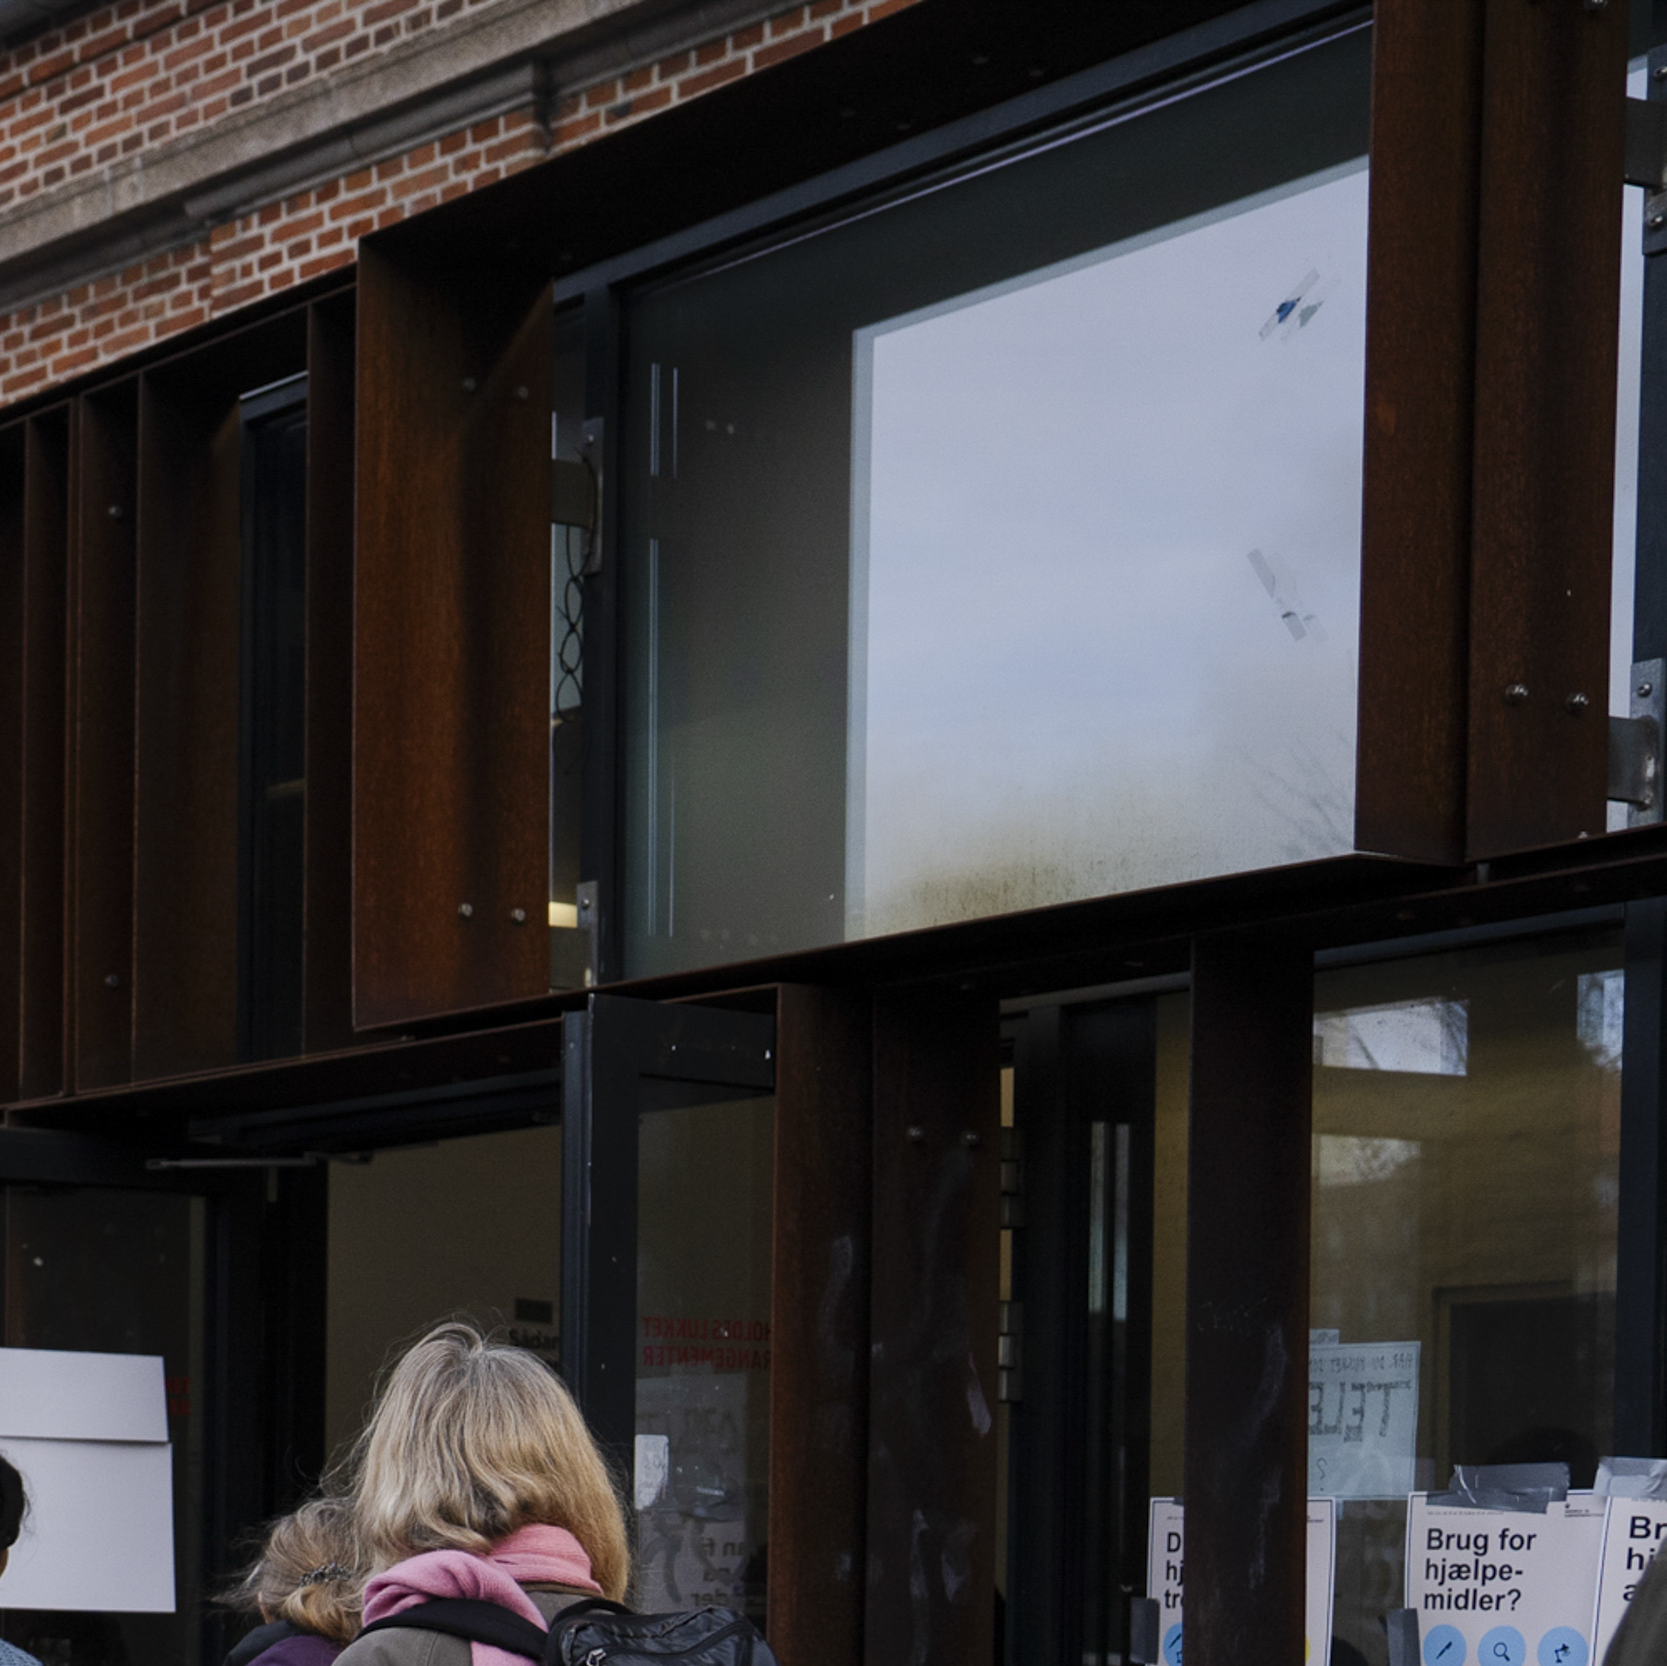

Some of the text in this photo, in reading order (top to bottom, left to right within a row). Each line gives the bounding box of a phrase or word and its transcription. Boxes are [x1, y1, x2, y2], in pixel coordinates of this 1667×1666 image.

[1427, 1528, 1537, 1557] Brug for
[1425, 1558, 1524, 1587] hjælpe-
[1423, 1588, 1522, 1611] midler?
